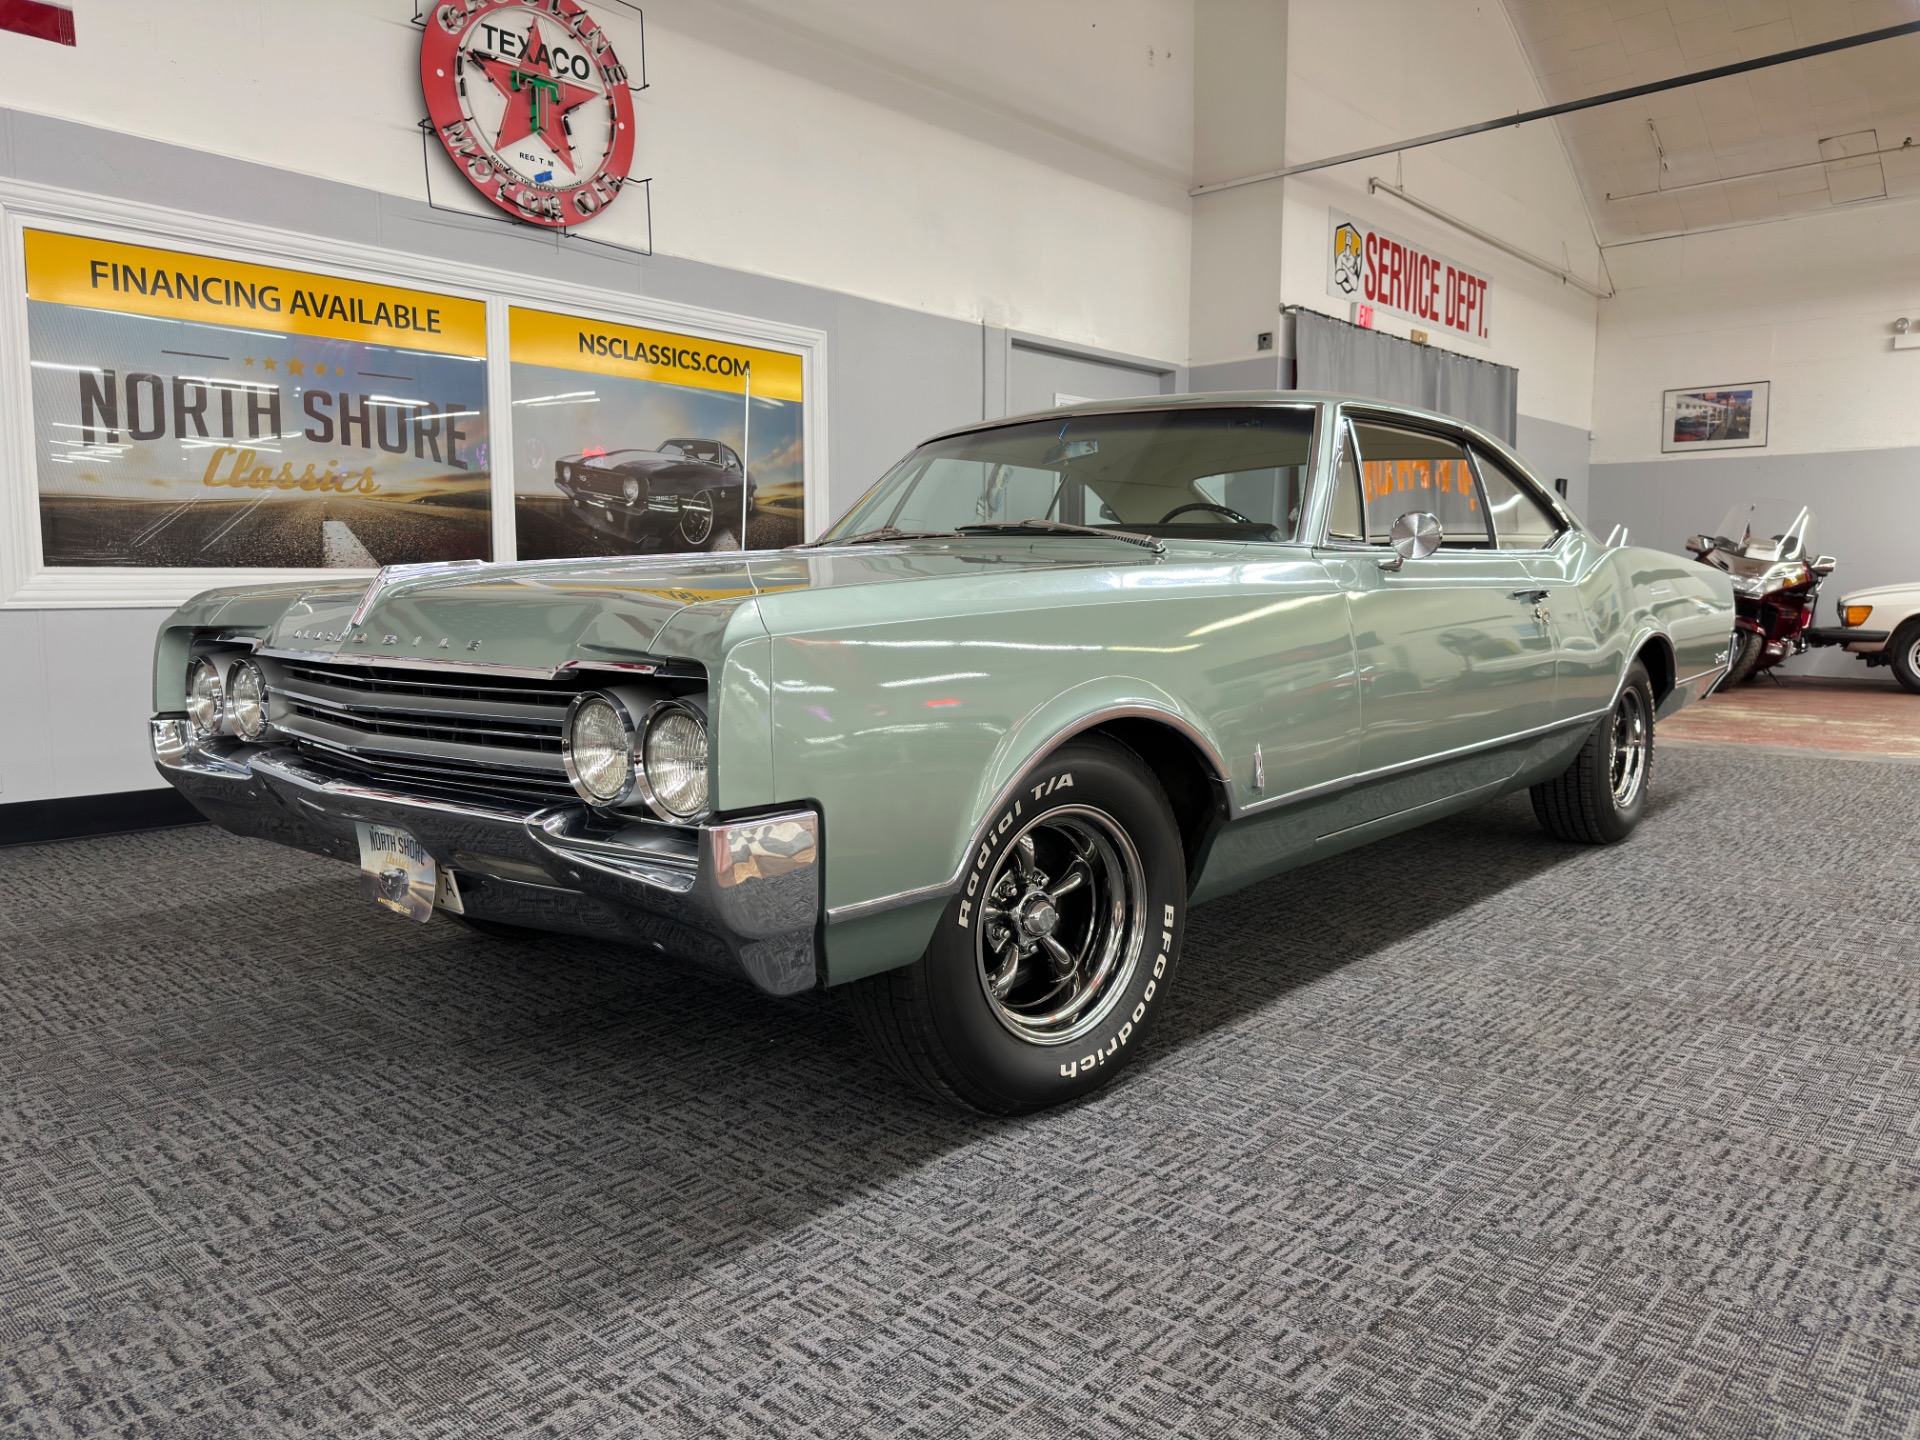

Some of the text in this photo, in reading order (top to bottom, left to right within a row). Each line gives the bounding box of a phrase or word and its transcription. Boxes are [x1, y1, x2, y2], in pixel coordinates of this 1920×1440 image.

[480, 22, 590, 80] TEXACO
[442, 119, 565, 223] MOTOR
[89, 259, 442, 334] FINANCING AVAILABLE
[1364, 231, 1488, 339] SERVICE DEPT.
[577, 331, 751, 379] NSCLASSICS.COM
[79, 368, 470, 471] NORTH SHORE
[202, 446, 382, 495] Classics
[369, 828, 397, 852] NORTH
[957, 772, 1074, 930] Radial T/A
[1060, 904, 1175, 1079] BFGoodrich
